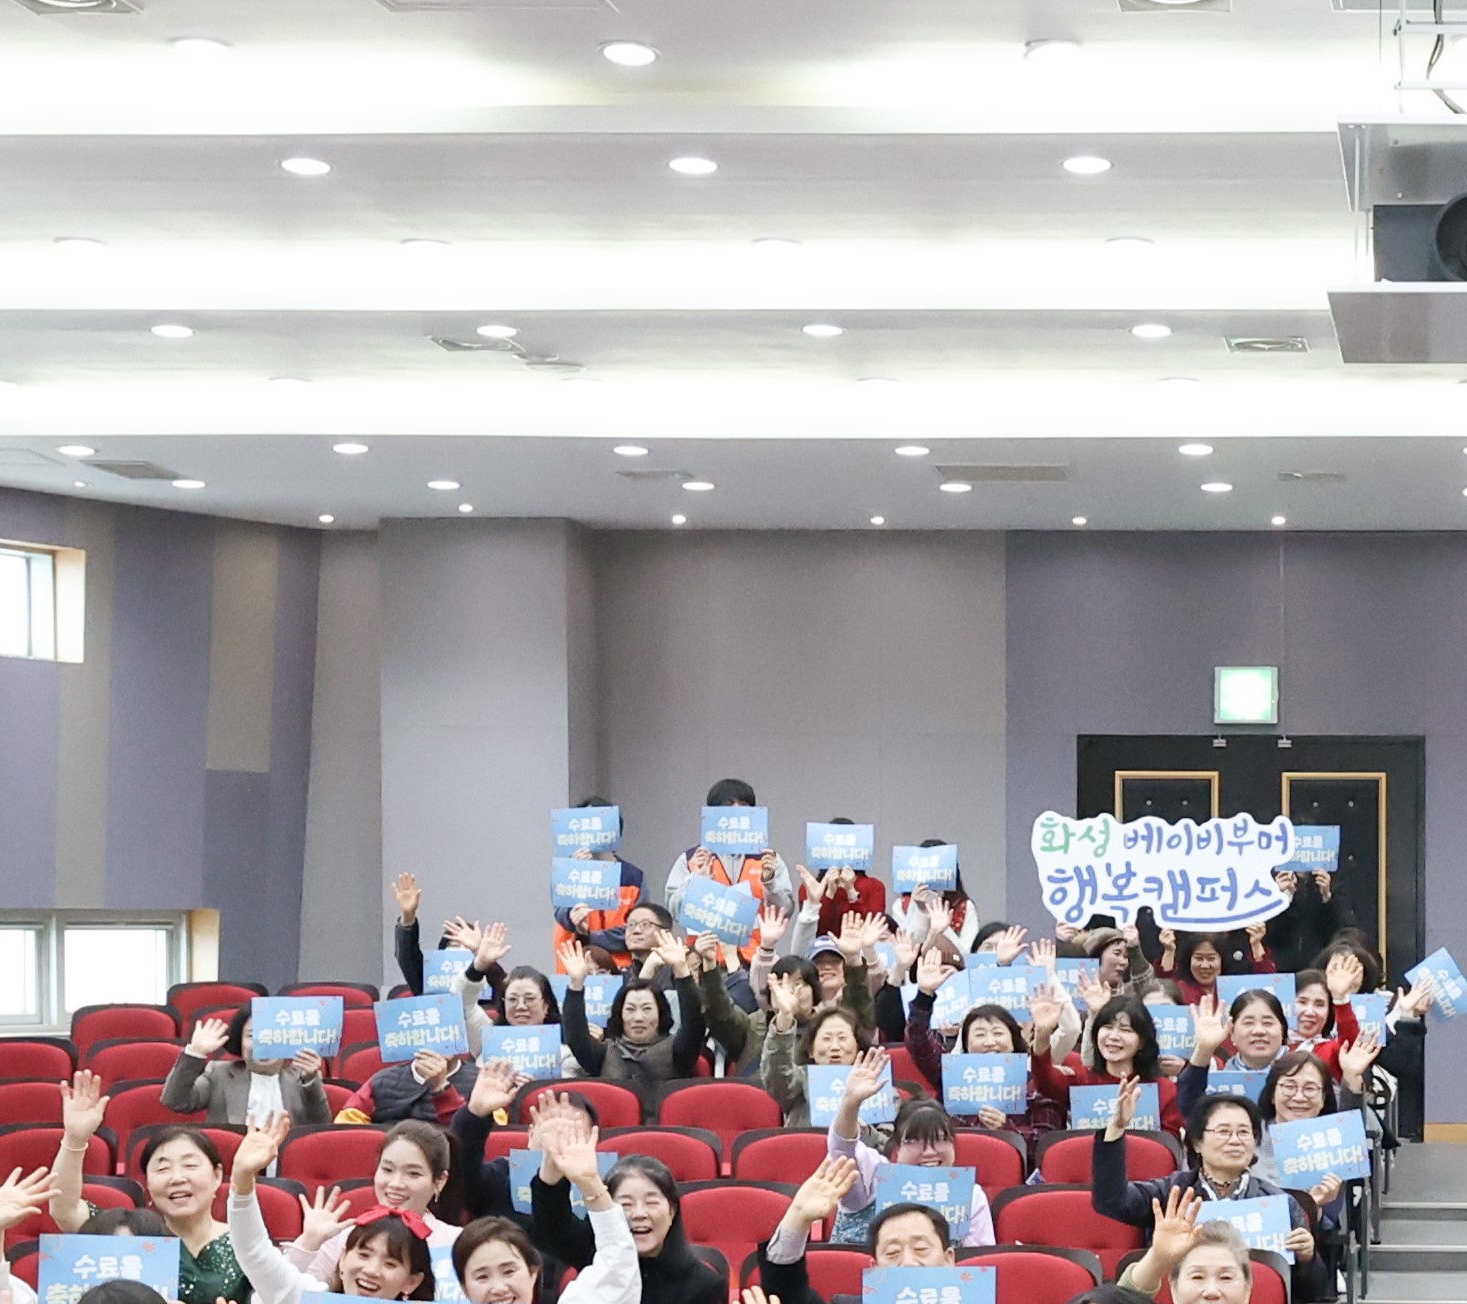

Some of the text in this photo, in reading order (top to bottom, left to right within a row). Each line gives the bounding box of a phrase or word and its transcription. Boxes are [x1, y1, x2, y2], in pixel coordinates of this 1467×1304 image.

[568, 816, 601, 831] 수료를
[718, 816, 750, 831] 수료를
[558, 829, 617, 847] 축하합니다!
[705, 829, 765, 845] 축하합니다!
[823, 832, 856, 846] 수료를
[1040, 817, 1289, 858] 화성 베이비부머
[810, 844, 869, 860] 축하합니다!
[908, 855, 939, 868] 수료를
[567, 869, 602, 883] 수료를
[555, 881, 615, 900] 축하합니다!
[702, 892, 736, 918] 수료를
[988, 977, 1027, 993] 수료를
[275, 1009, 321, 1026] 수료를
[398, 1008, 441, 1026] 수료를
[258, 1027, 336, 1046] 축하합니다!
[385, 1024, 459, 1048] 축하합니다!
[501, 1036, 540, 1052] 수료를
[963, 1065, 1005, 1083] 수료를
[949, 1083, 1020, 1102] 축하합니다!
[1093, 1098, 1119, 1115] 수료
[1296, 1132, 1342, 1155] 수료를
[1283, 1147, 1362, 1178] 축하합니다!
[901, 1181, 949, 1202] 수료를
[1230, 1212, 1262, 1233] 료를
[72, 1255, 143, 1280] 수료를
